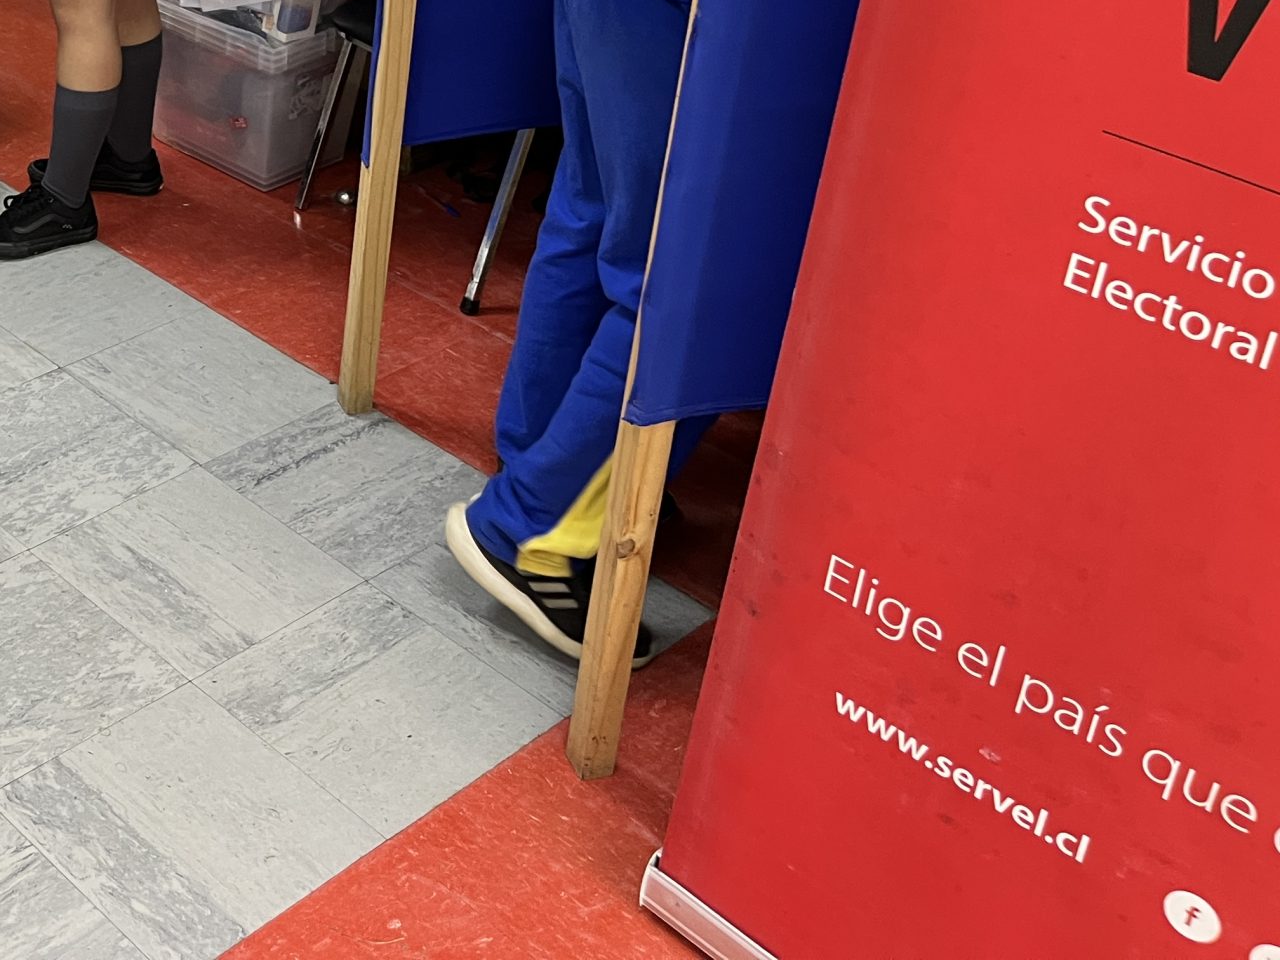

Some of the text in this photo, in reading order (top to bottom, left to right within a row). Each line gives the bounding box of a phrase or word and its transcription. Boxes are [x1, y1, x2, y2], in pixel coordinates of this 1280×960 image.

[1063, 252, 1279, 370] Electoral
[1078, 195, 1276, 299] Servicio
[823, 554, 1259, 834] Elige el país que
[835, 691, 1090, 863] www.servel.cl
